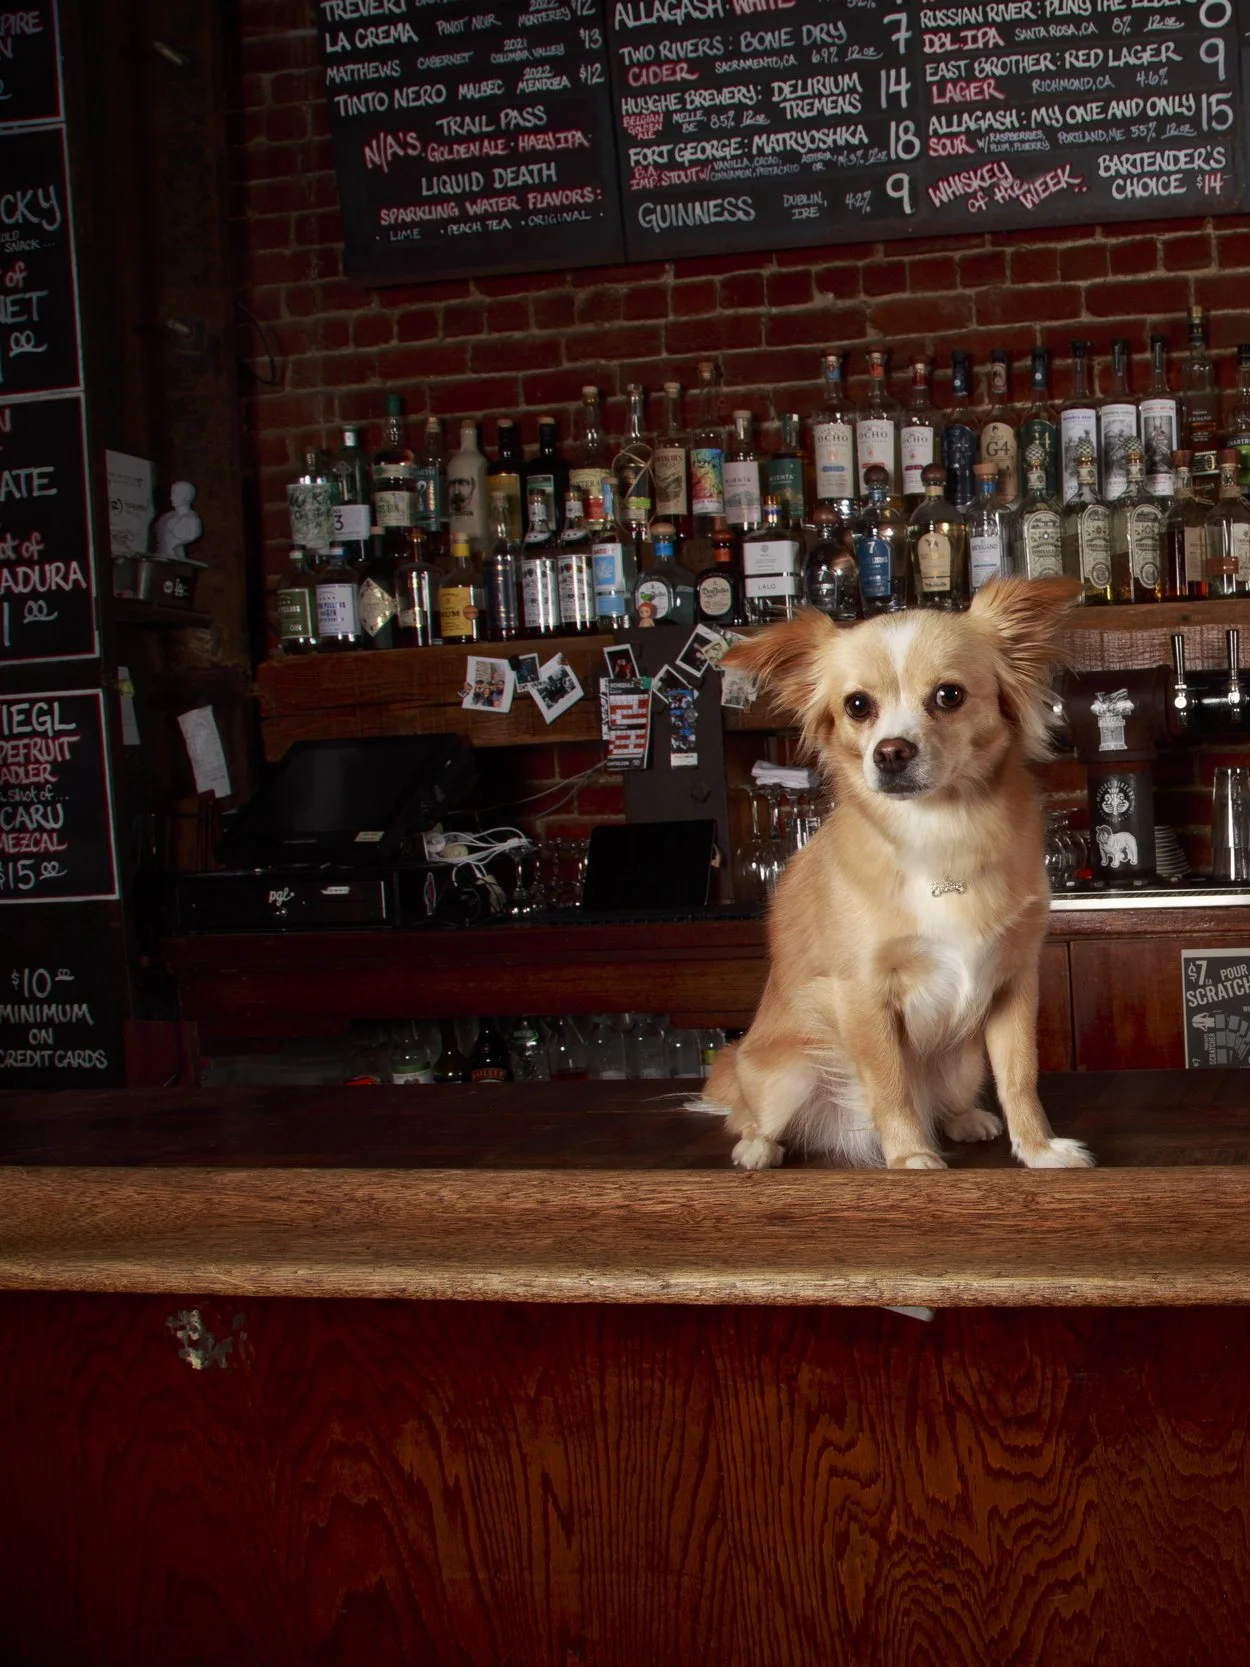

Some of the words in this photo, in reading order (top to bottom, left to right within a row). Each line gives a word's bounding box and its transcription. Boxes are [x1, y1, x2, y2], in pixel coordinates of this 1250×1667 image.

[325, 31, 352, 53] LA
[355, 22, 420, 49] CREMA
[436, 16, 469, 36] PINOT
[471, 13, 502, 31] NOIR
[518, 6, 571, 28] MONTEREY
[614, 0, 724, 31] ALLAGASH
[920, 4, 984, 28] RUSSIAN
[619, 44, 655, 66] TWO
[740, 27, 795, 53] BONE
[802, 20, 847, 46] DRY
[883, 12, 912, 55] 7
[961, 26, 1006, 50] IPA
[1014, 26, 1049, 41] SANTA
[326, 59, 402, 86] MATTHEWS
[417, 51, 475, 70] CABERNET
[579, 27, 602, 49] $13
[925, 60, 971, 82] EAST
[1064, 48, 1104, 69] RED
[1108, 41, 1184, 67] LAGER
[1199, 37, 1226, 81] 9
[334, 90, 390, 117] TINTO
[394, 83, 447, 110] NERO
[458, 79, 505, 100] MALBEC
[516, 74, 571, 95] MENDOZA
[579, 62, 605, 85] $12
[628, 61, 699, 87] CIDER
[621, 91, 682, 116] HUYGHE
[771, 71, 863, 102] DELIRIUM
[880, 66, 912, 110] 14
[779, 93, 862, 120] TREMENS
[932, 78, 1006, 104] LAGER
[435, 114, 495, 136] TRAIL
[500, 105, 547, 130] PASS
[1031, 105, 1064, 129] MY
[1066, 101, 1106, 124] ONE
[1107, 97, 1144, 120] AND
[1146, 92, 1196, 117] ONLY
[1201, 91, 1234, 132] 15
[427, 142, 480, 163] GOLDEN
[482, 139, 509, 156] ALE
[519, 132, 554, 150] HAZY
[557, 130, 590, 149] IPA
[628, 144, 674, 167] FORT
[752, 124, 869, 155] MATRYOSHKA
[890, 120, 921, 160] 18
[928, 135, 976, 157] SOUR
[661, 167, 702, 187] STOUT
[1098, 145, 1226, 178] BARTENDER'S
[421, 170, 484, 197] LIQUID
[492, 161, 557, 189] DEATH
[928, 161, 1014, 208] WHISKEY
[1112, 173, 1187, 200] CHOICE
[380, 201, 460, 226] SPARKLING
[465, 194, 521, 217] WATER
[638, 196, 756, 233] GUINNESS
[885, 172, 915, 215] 9
[390, 228, 421, 242] LIME
[448, 219, 482, 236] PEACH
[485, 218, 512, 231] TEA
[528, 210, 592, 227] ORIGINAL
[986, 441, 1010, 456] G4
[1220, 964, 1249, 981] POUR
[0, 1003, 95, 1026] MINIMUM
[29, 1026, 54, 1046] ON
[55, 1048, 109, 1069] CARDS
